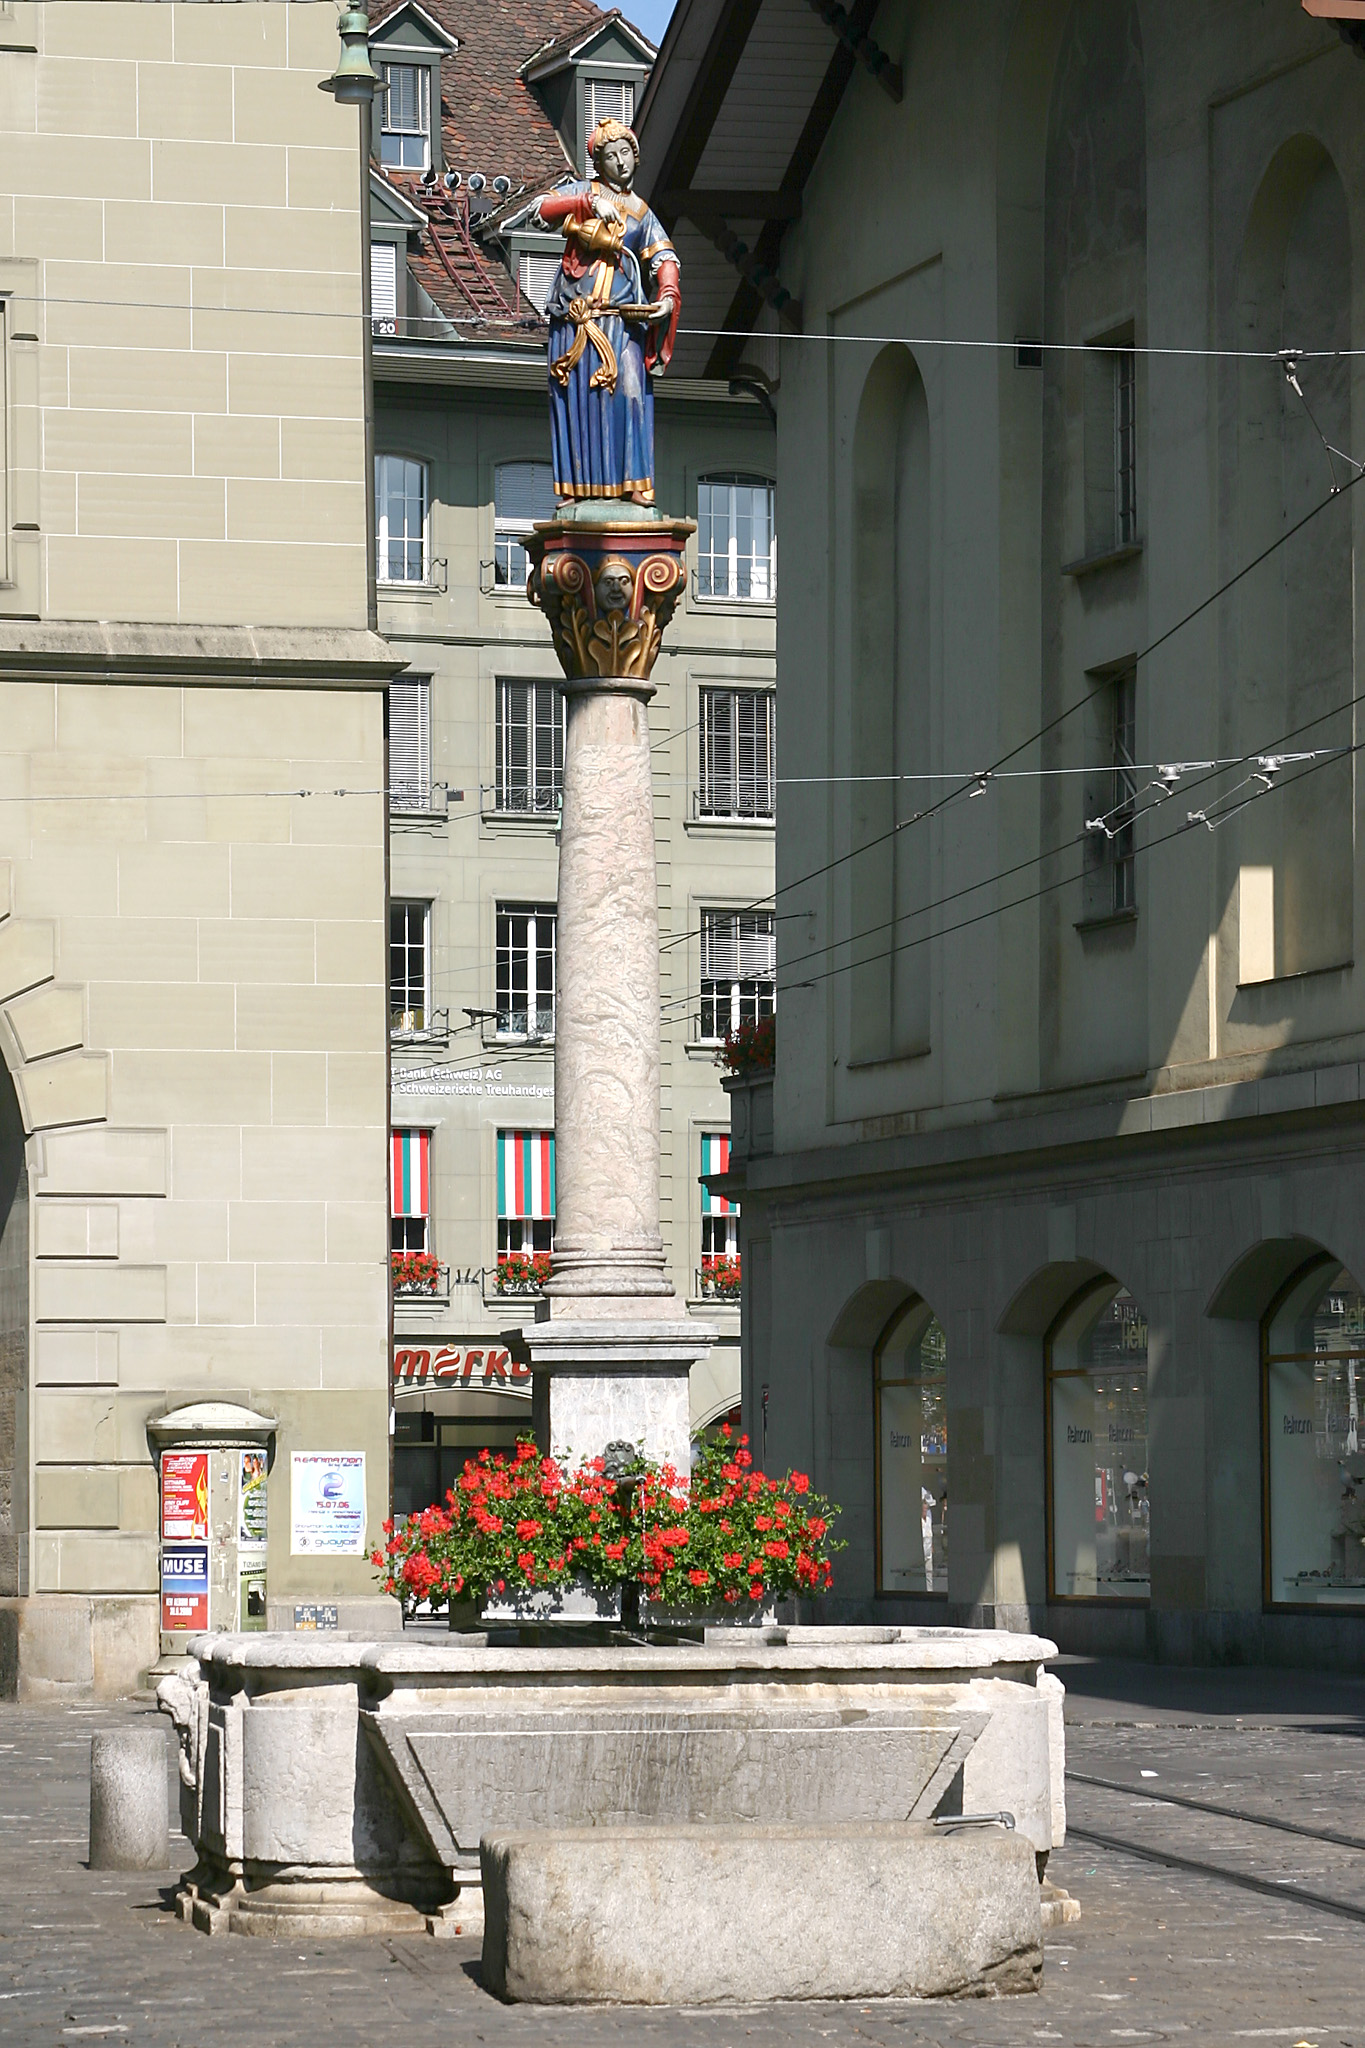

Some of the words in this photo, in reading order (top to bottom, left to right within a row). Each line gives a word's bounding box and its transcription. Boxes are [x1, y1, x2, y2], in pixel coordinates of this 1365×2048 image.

[379, 322, 395, 334] 20
[400, 1068, 427, 1080] Bank
[431, 1068, 482, 1081] (Schweiz)
[485, 1070, 502, 1081] AG
[400, 1083, 482, 1095] Schweizerische
[485, 1084, 554, 1098] Treuhandges
[316, 1501, 350, 1509] 15.07.06
[163, 1559, 204, 1574] MUSE
